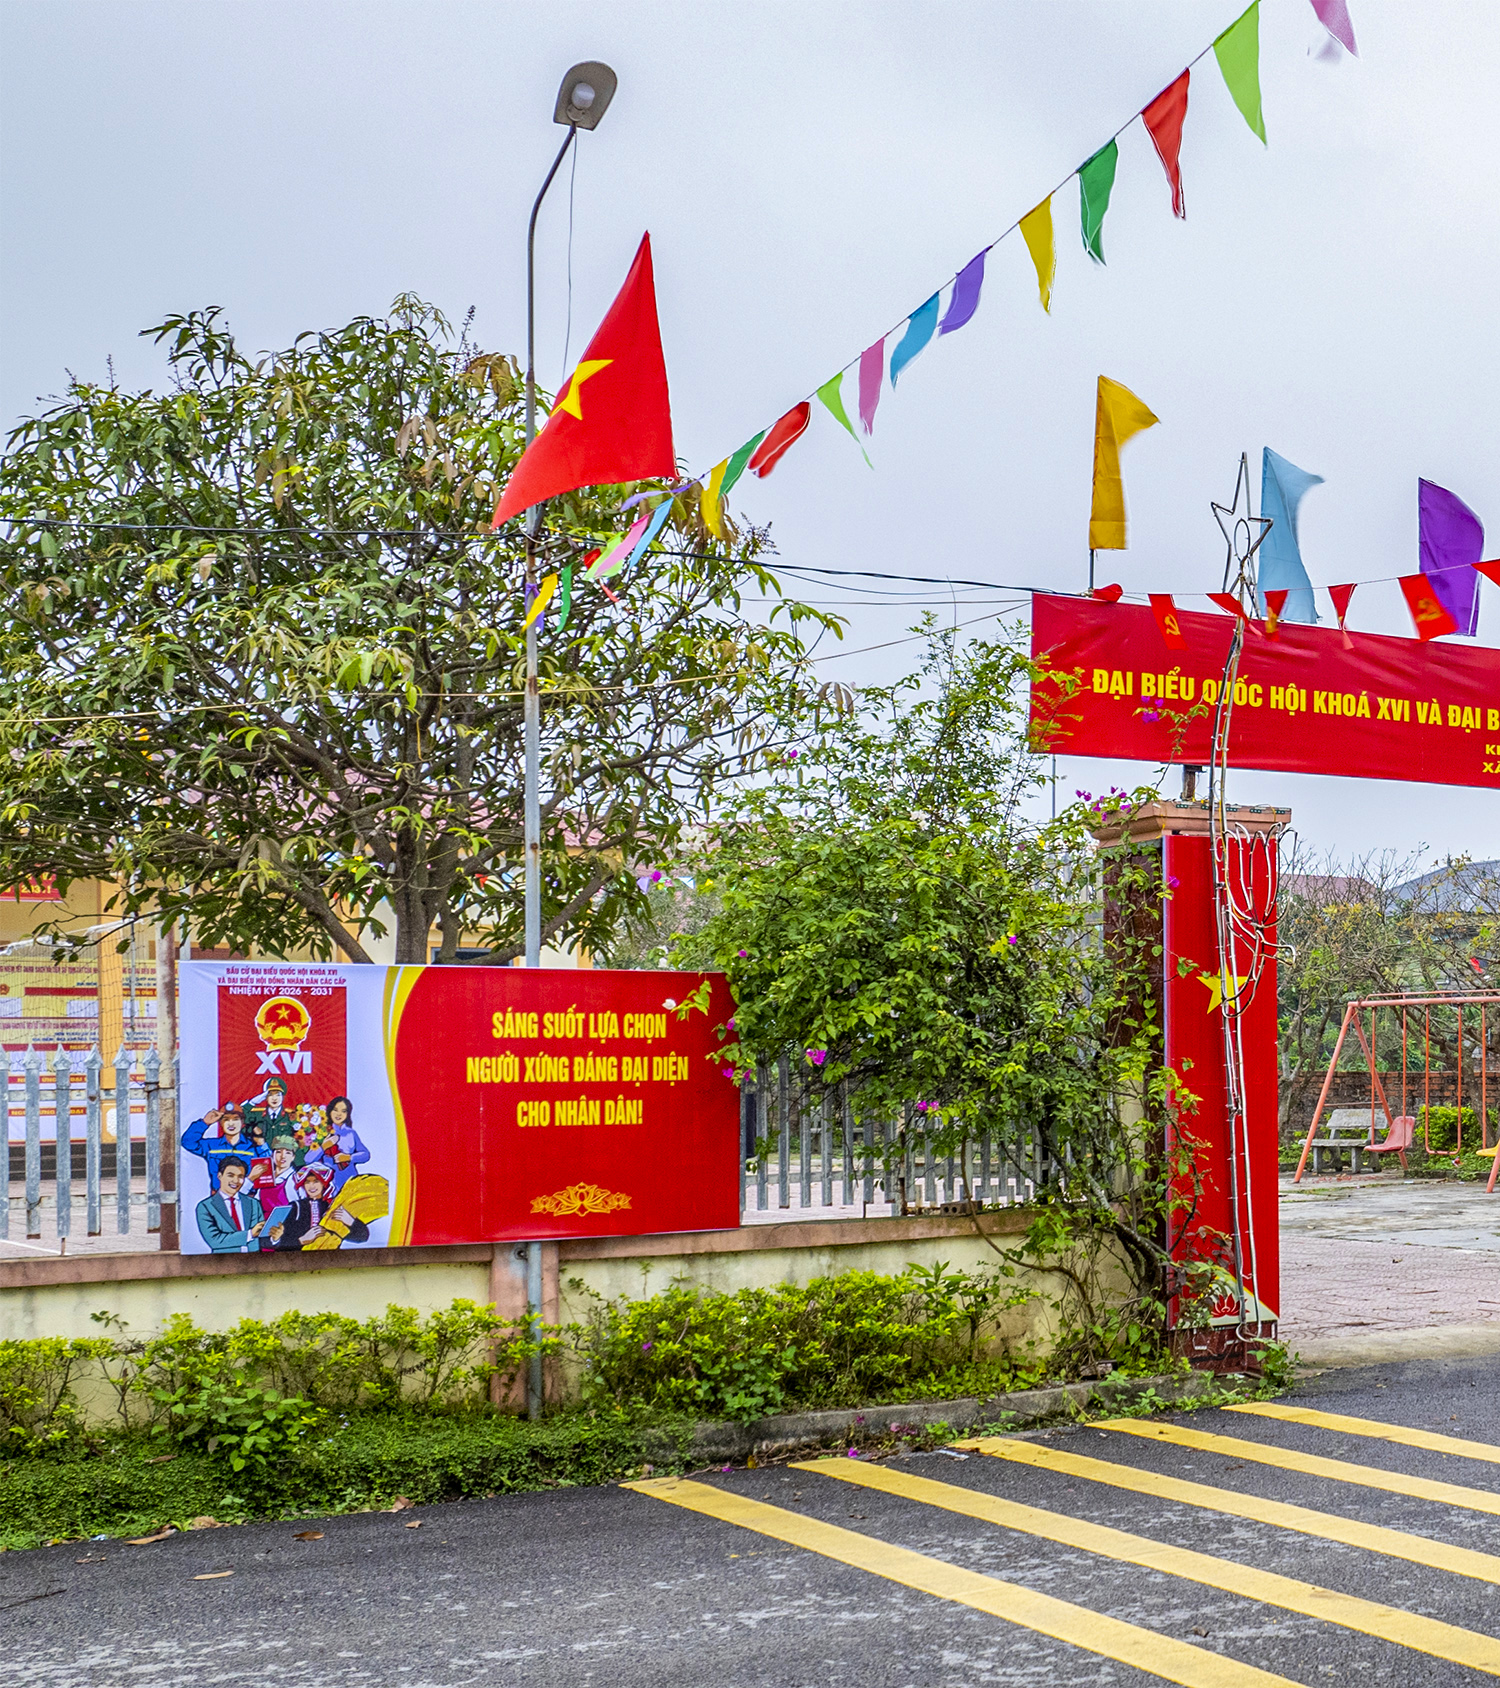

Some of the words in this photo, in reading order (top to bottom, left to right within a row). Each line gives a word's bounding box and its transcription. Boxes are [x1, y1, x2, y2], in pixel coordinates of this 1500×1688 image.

[1092, 669, 1133, 700] ĐẠI
[1141, 666, 1195, 701] BIỂU
[1270, 683, 1307, 716] HỘI
[1313, 691, 1371, 718] KHOÁ
[1376, 697, 1410, 722] XVI
[1416, 698, 1443, 725] VÀ
[1448, 704, 1481, 733] ĐẠI
[229, 986, 261, 996] NHIỆM
[278, 987, 301, 995] 2026
[310, 987, 332, 995] 2031
[492, 1006, 539, 1039] SÁNG
[543, 1003, 585, 1039] SUỐT
[589, 1010, 620, 1044] LỰA
[623, 1013, 667, 1044] CHỌN
[255, 1051, 312, 1074] XVI
[466, 1050, 519, 1083] NGƯỜI
[524, 1051, 570, 1083] XỨNG
[573, 1051, 618, 1082] ĐÁNG
[621, 1056, 648, 1087] ĐẠI
[652, 1051, 689, 1087] DIỆN
[517, 1101, 551, 1127] CHO
[554, 1095, 601, 1126] NHÂN
[604, 1094, 643, 1125] DÂN!
